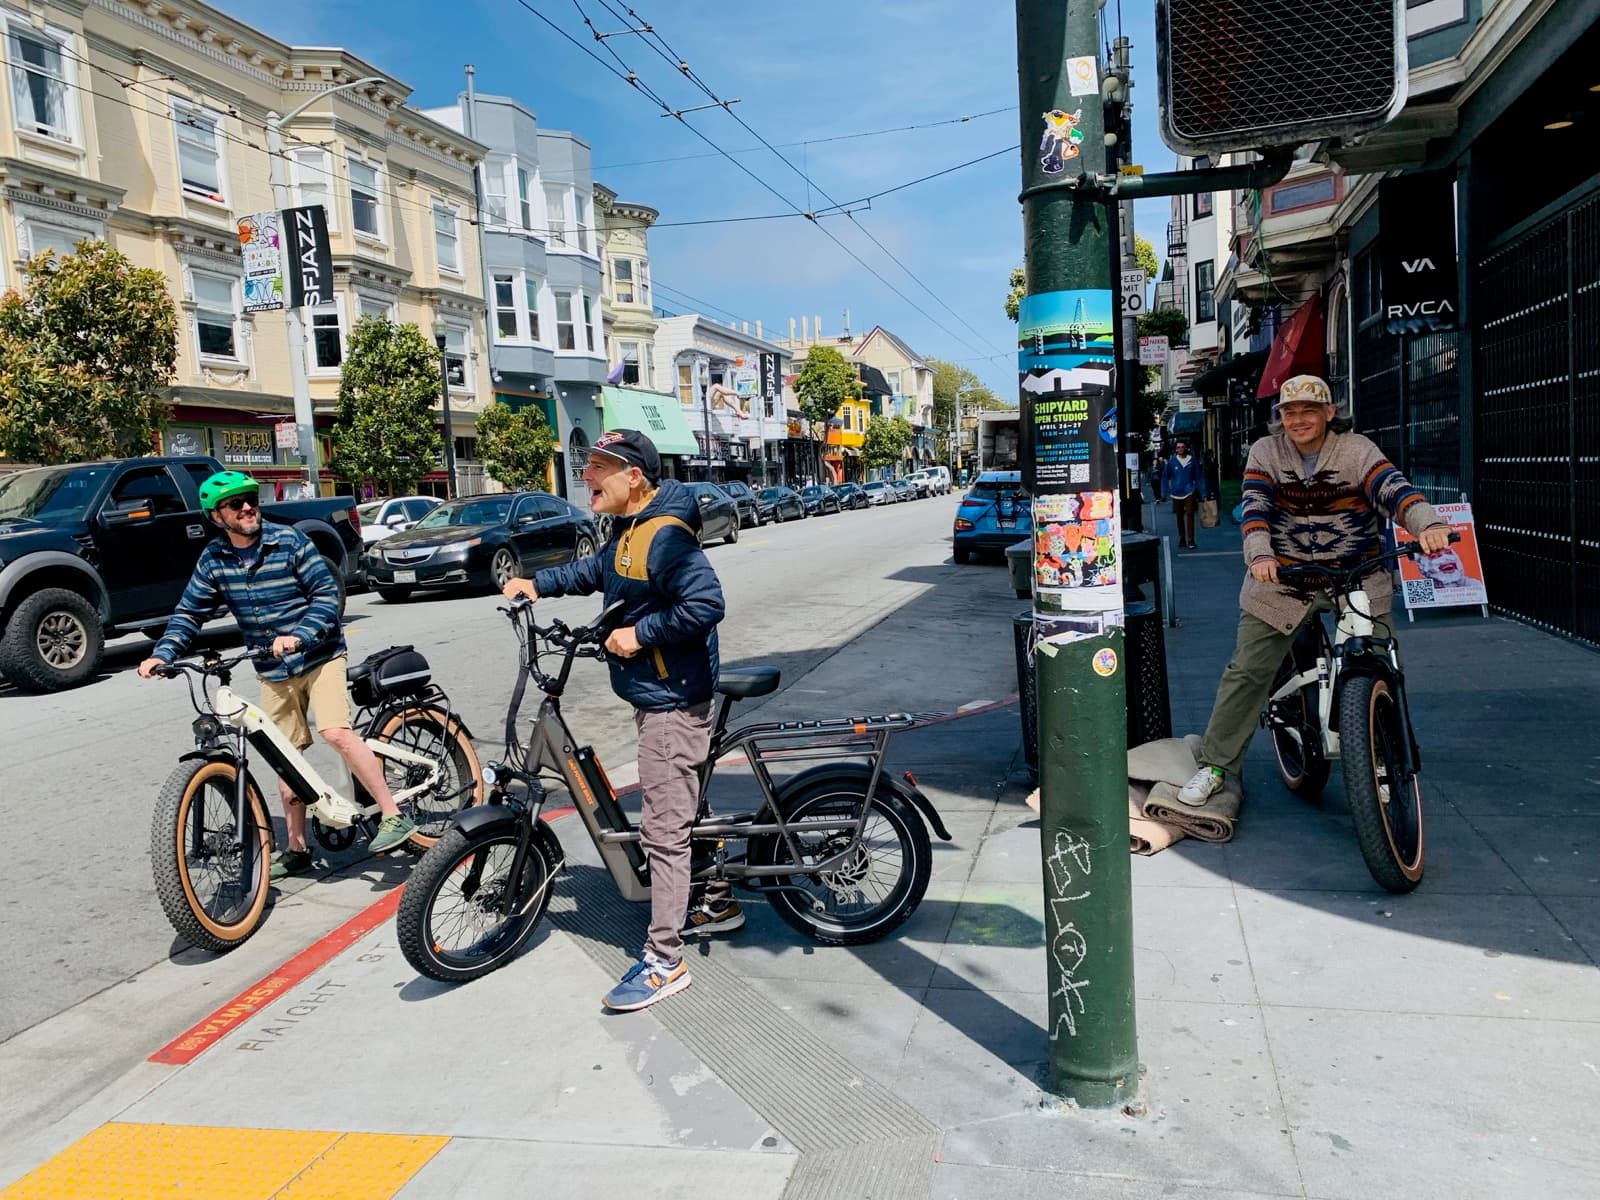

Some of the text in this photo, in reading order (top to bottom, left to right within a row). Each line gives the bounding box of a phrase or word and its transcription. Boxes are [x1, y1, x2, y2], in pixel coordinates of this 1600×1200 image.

[295, 209, 320, 307] SFJAZZ
[1121, 274, 1142, 283] EED
[1122, 284, 1139, 292] MIT
[1387, 299, 1454, 319] RVCA
[766, 354, 775, 398] SFJAZZ
[1034, 400, 1088, 414] SHIPYARD
[1034, 412, 1088, 424] OPEN STUDIOS
[1438, 504, 1467, 513] OXIDE
[236, 979, 346, 1051] HAIGHT
